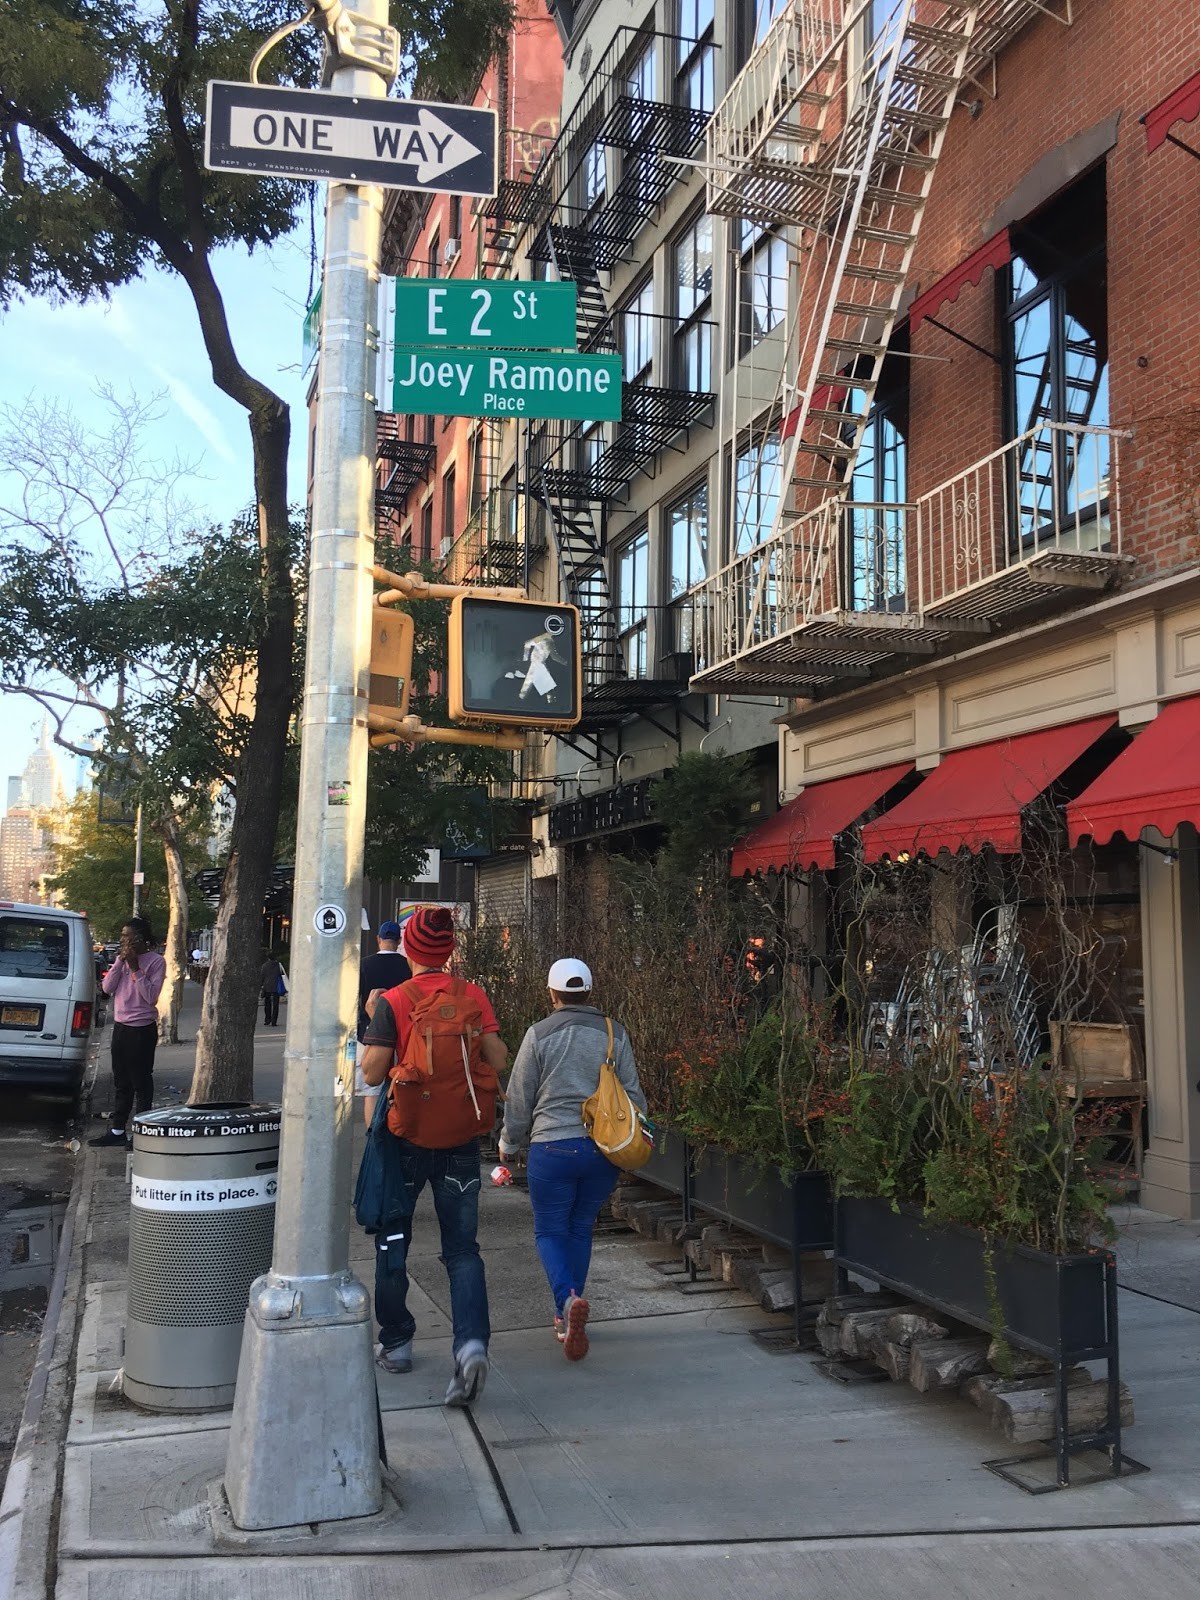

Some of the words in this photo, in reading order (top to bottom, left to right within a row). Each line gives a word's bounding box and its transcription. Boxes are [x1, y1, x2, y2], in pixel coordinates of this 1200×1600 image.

[253, 113, 333, 152] ONE
[373, 125, 454, 164] WAY
[265, 163, 330, 175] TRANSPORTATION
[428, 288, 447, 336] E
[470, 288, 492, 337] 2
[513, 290, 538, 320] St
[400, 354, 474, 396] Joey
[489, 357, 611, 394] Ramone
[483, 393, 525, 411] Place
[141, 1125, 165, 1136] Don't
[168, 1127, 197, 1137] litter
[220, 1124, 255, 1136] Don't
[135, 1185, 147, 1198] Put
[149, 1188, 177, 1201] litter
[180, 1190, 192, 1201] in
[196, 1190, 215, 1201] its
[219, 1188, 259, 1203] place.
